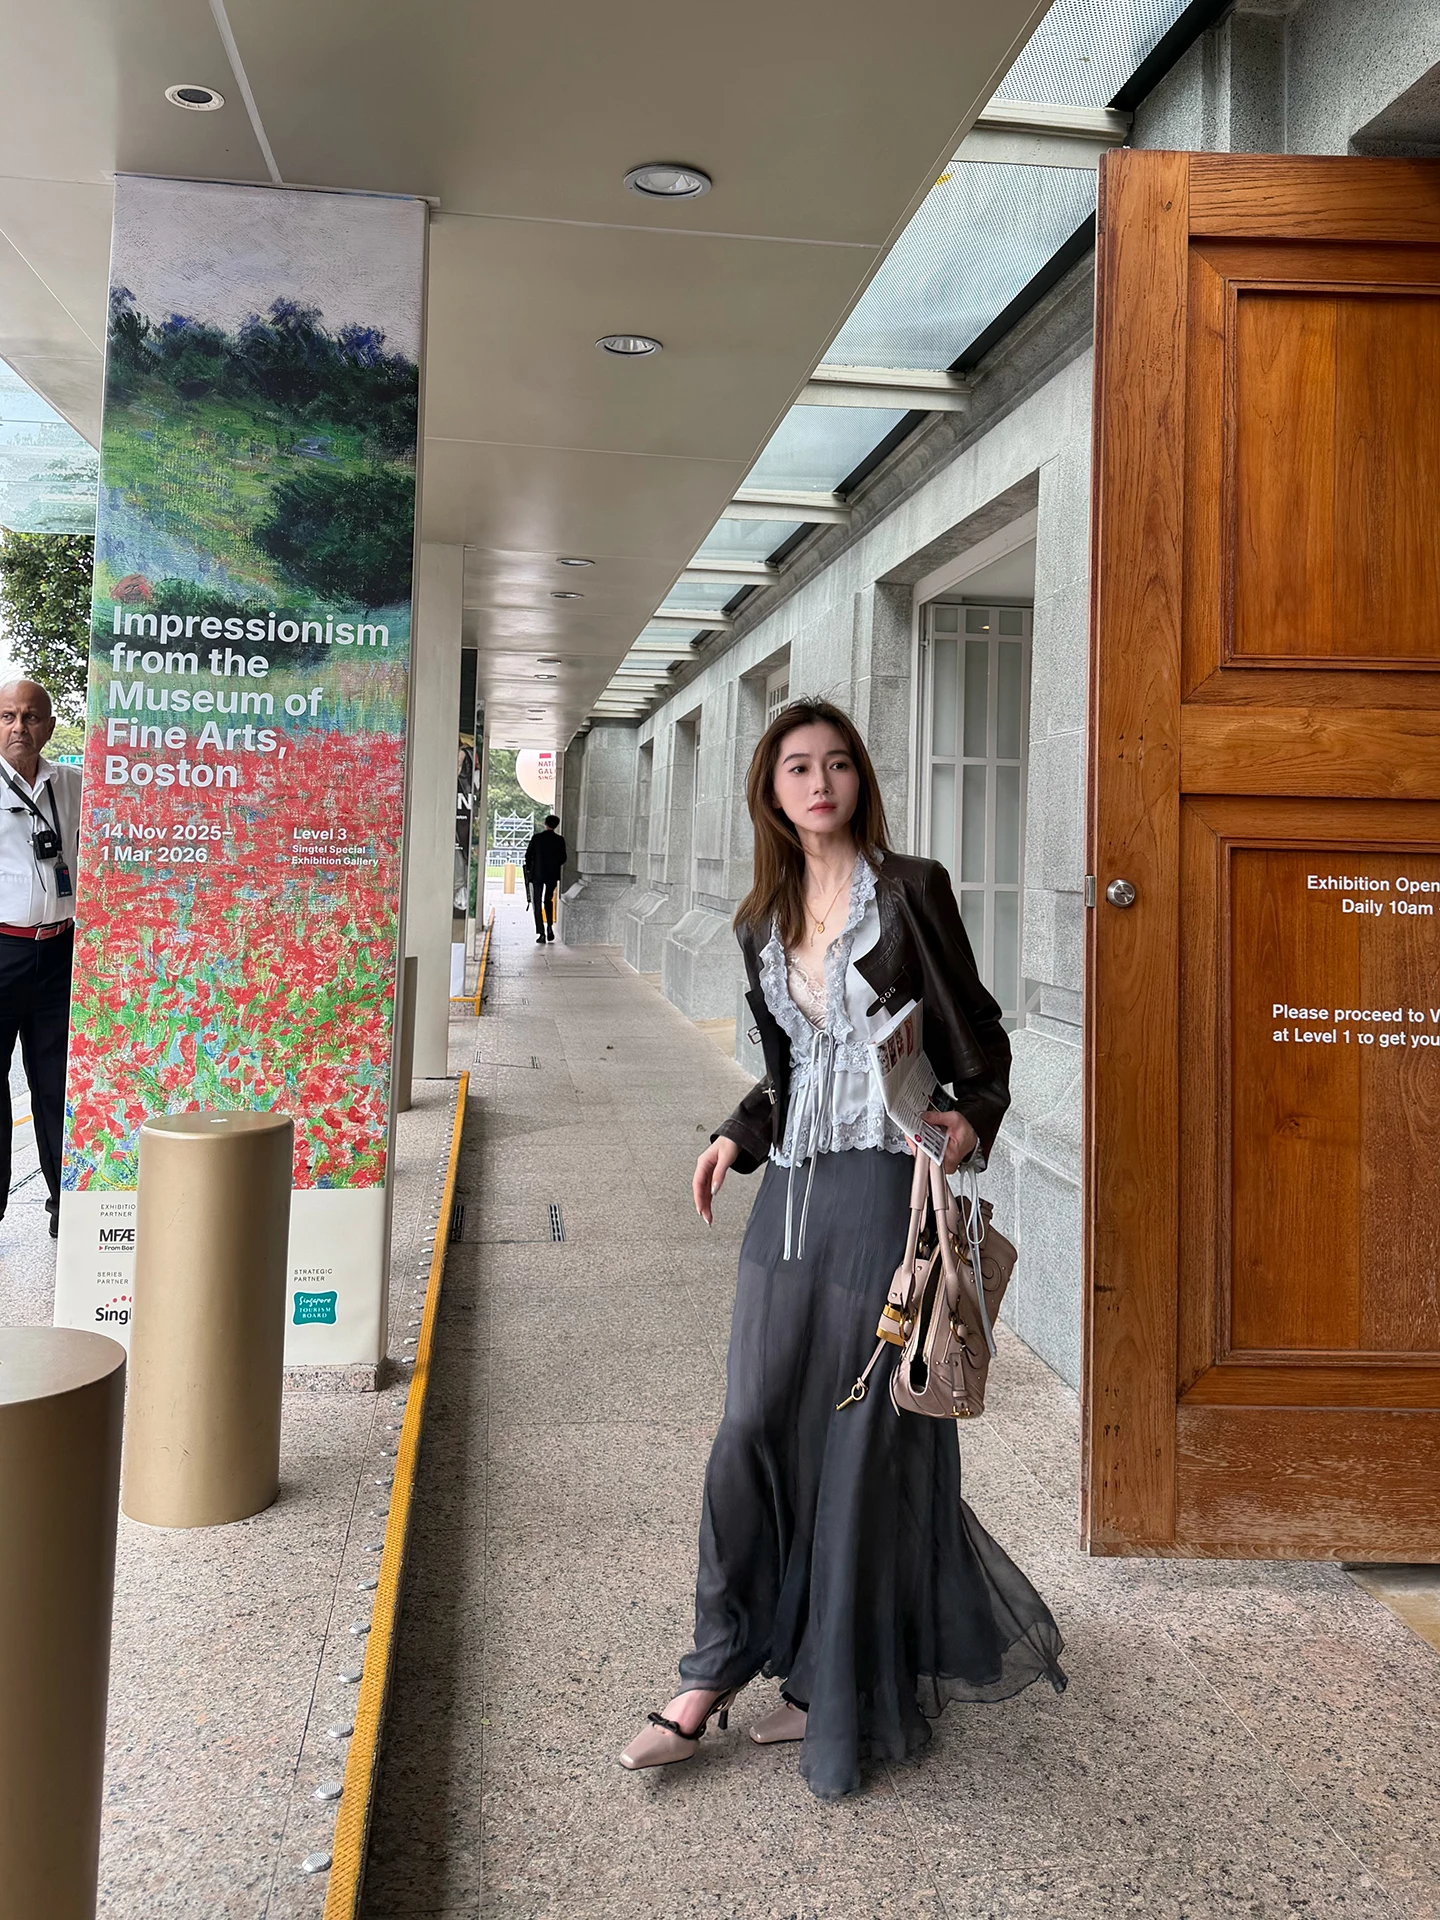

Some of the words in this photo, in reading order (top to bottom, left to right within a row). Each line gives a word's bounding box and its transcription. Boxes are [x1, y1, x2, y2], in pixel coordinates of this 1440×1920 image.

[113, 606, 389, 646] Impressionism
[110, 642, 199, 675] from
[209, 647, 269, 678] the
[108, 680, 274, 715] Museum
[284, 687, 324, 717] of
[106, 717, 187, 750] Fine
[196, 721, 287, 760] Arts,
[104, 755, 238, 788] Boston
[101, 823, 123, 839] 14
[128, 824, 168, 839] Nov
[293, 827, 333, 840] Level
[338, 828, 347, 840] 3
[101, 846, 109, 861] 1
[114, 846, 153, 862] Mar
[157, 847, 208, 862] 2026
[292, 845, 327, 854] Singtel
[329, 846, 366, 855] Special
[292, 856, 341, 865] Exhibition
[343, 857, 378, 867] Gallery
[1308, 875, 1390, 891] Exhibition
[1342, 899, 1383, 916] Daily
[1389, 901, 1433, 915] 10am
[1272, 1004, 1329, 1020] Please
[1334, 1008, 1402, 1022] proceed
[1408, 1008, 1424, 1023] to
[1273, 1028, 1289, 1042] at
[1294, 1028, 1337, 1043] Level
[1343, 1030, 1350, 1043] 1
[1357, 1032, 1374, 1044] to
[1379, 1031, 1406, 1048] get
